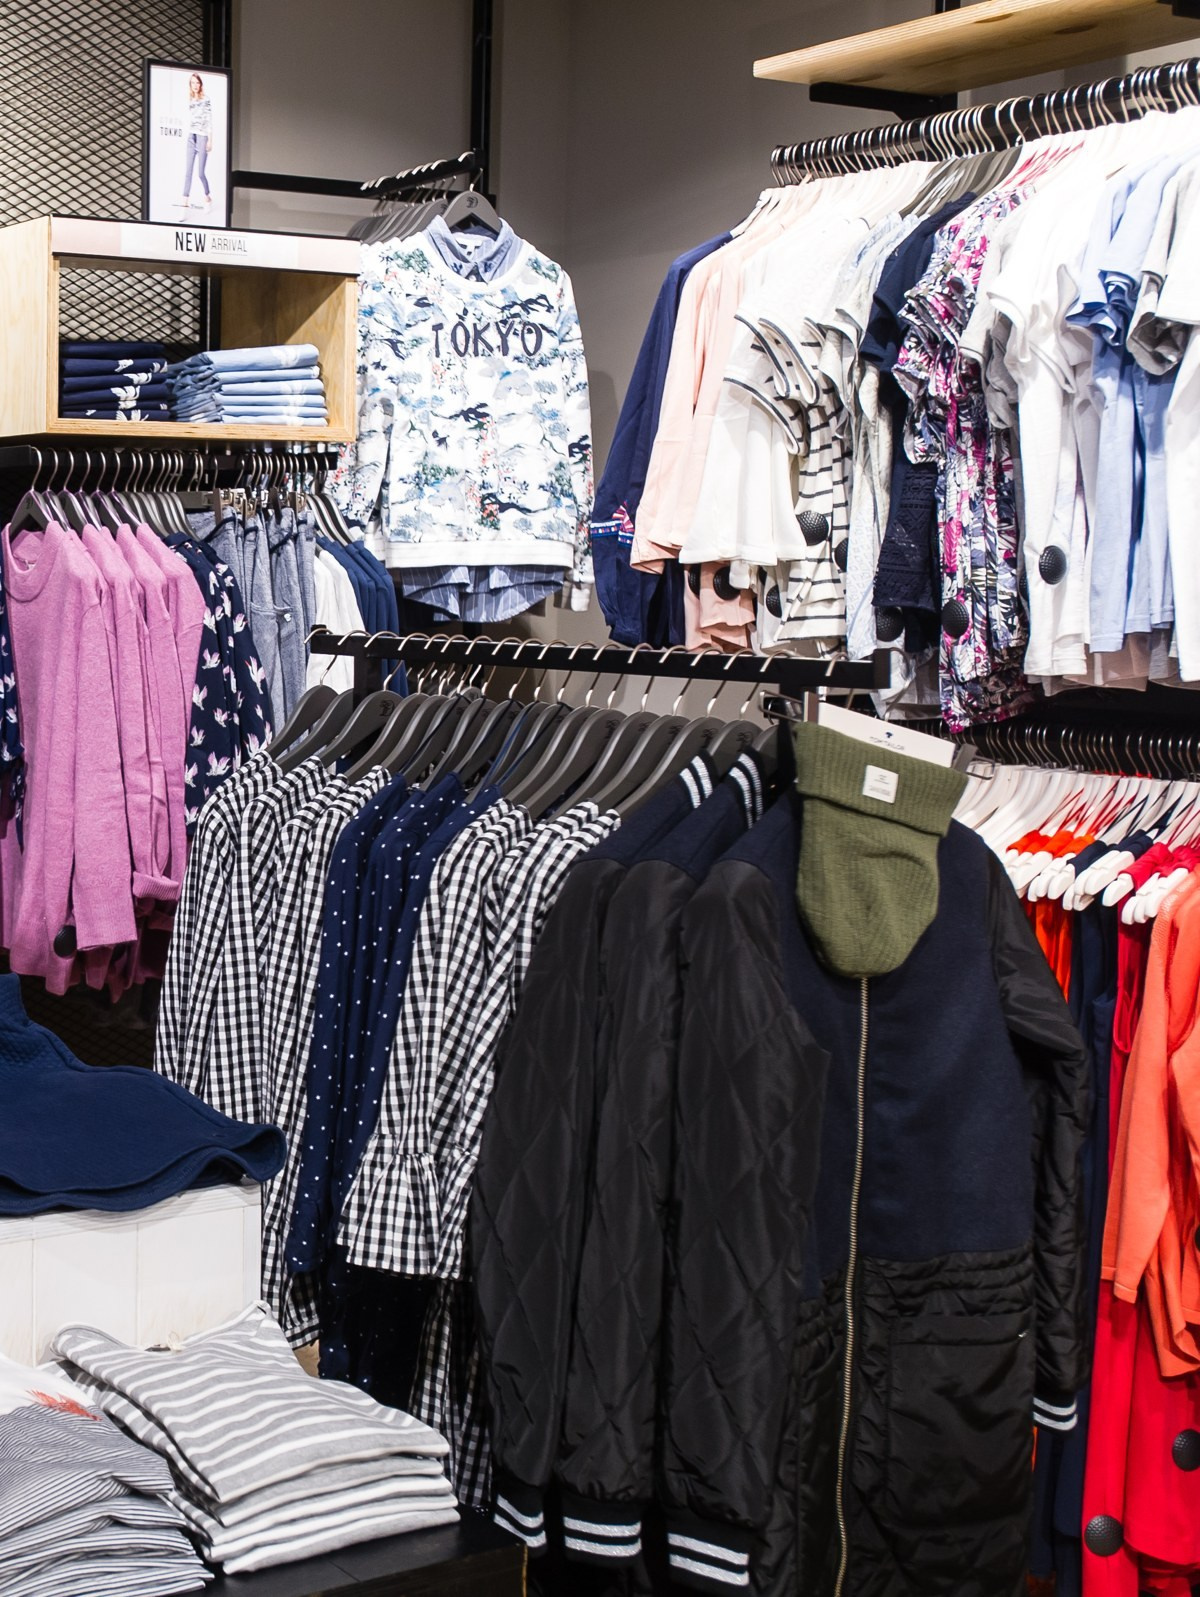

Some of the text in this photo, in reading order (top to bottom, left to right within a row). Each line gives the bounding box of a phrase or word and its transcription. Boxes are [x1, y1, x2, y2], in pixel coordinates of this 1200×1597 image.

[175, 231, 248, 252] NEW ARRIVAL
[432, 321, 543, 358] TOKYO
